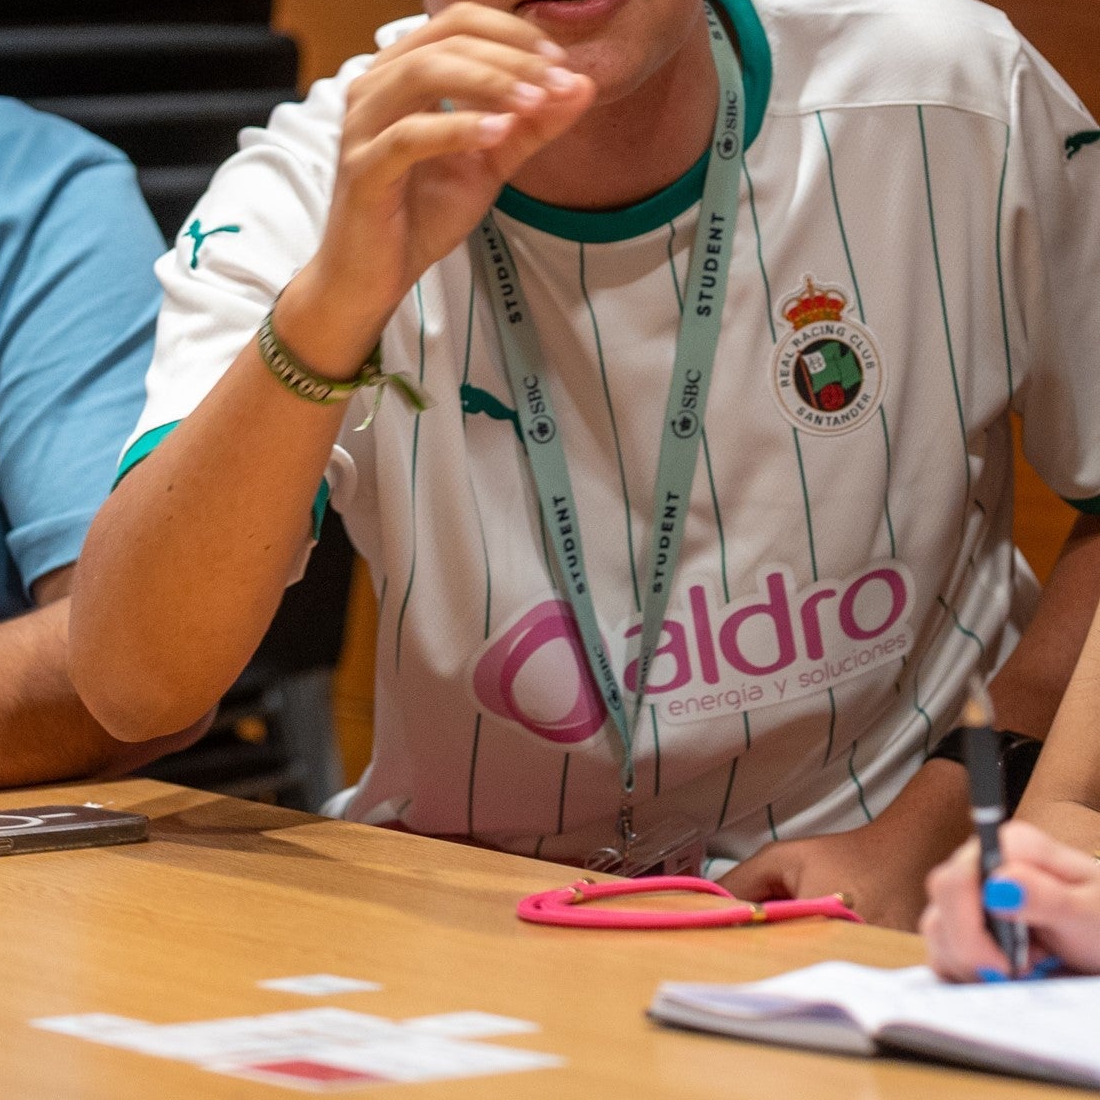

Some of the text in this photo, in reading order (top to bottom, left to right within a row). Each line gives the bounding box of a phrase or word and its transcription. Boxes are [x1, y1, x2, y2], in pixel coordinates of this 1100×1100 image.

[482, 225, 522, 324] STUDENT
[696, 213, 726, 317] STUDENT
[523, 374, 546, 415] SBC
[682, 369, 701, 410] SBC
[779, 324, 876, 387] REAL RACING CLUB
[796, 393, 872, 426] SANTANDER
[552, 492, 586, 595] STUDENT
[652, 491, 680, 594] STUDENT
[623, 567, 908, 695] aldro
[773, 678, 788, 699] y
[799, 633, 908, 688] soluciones
